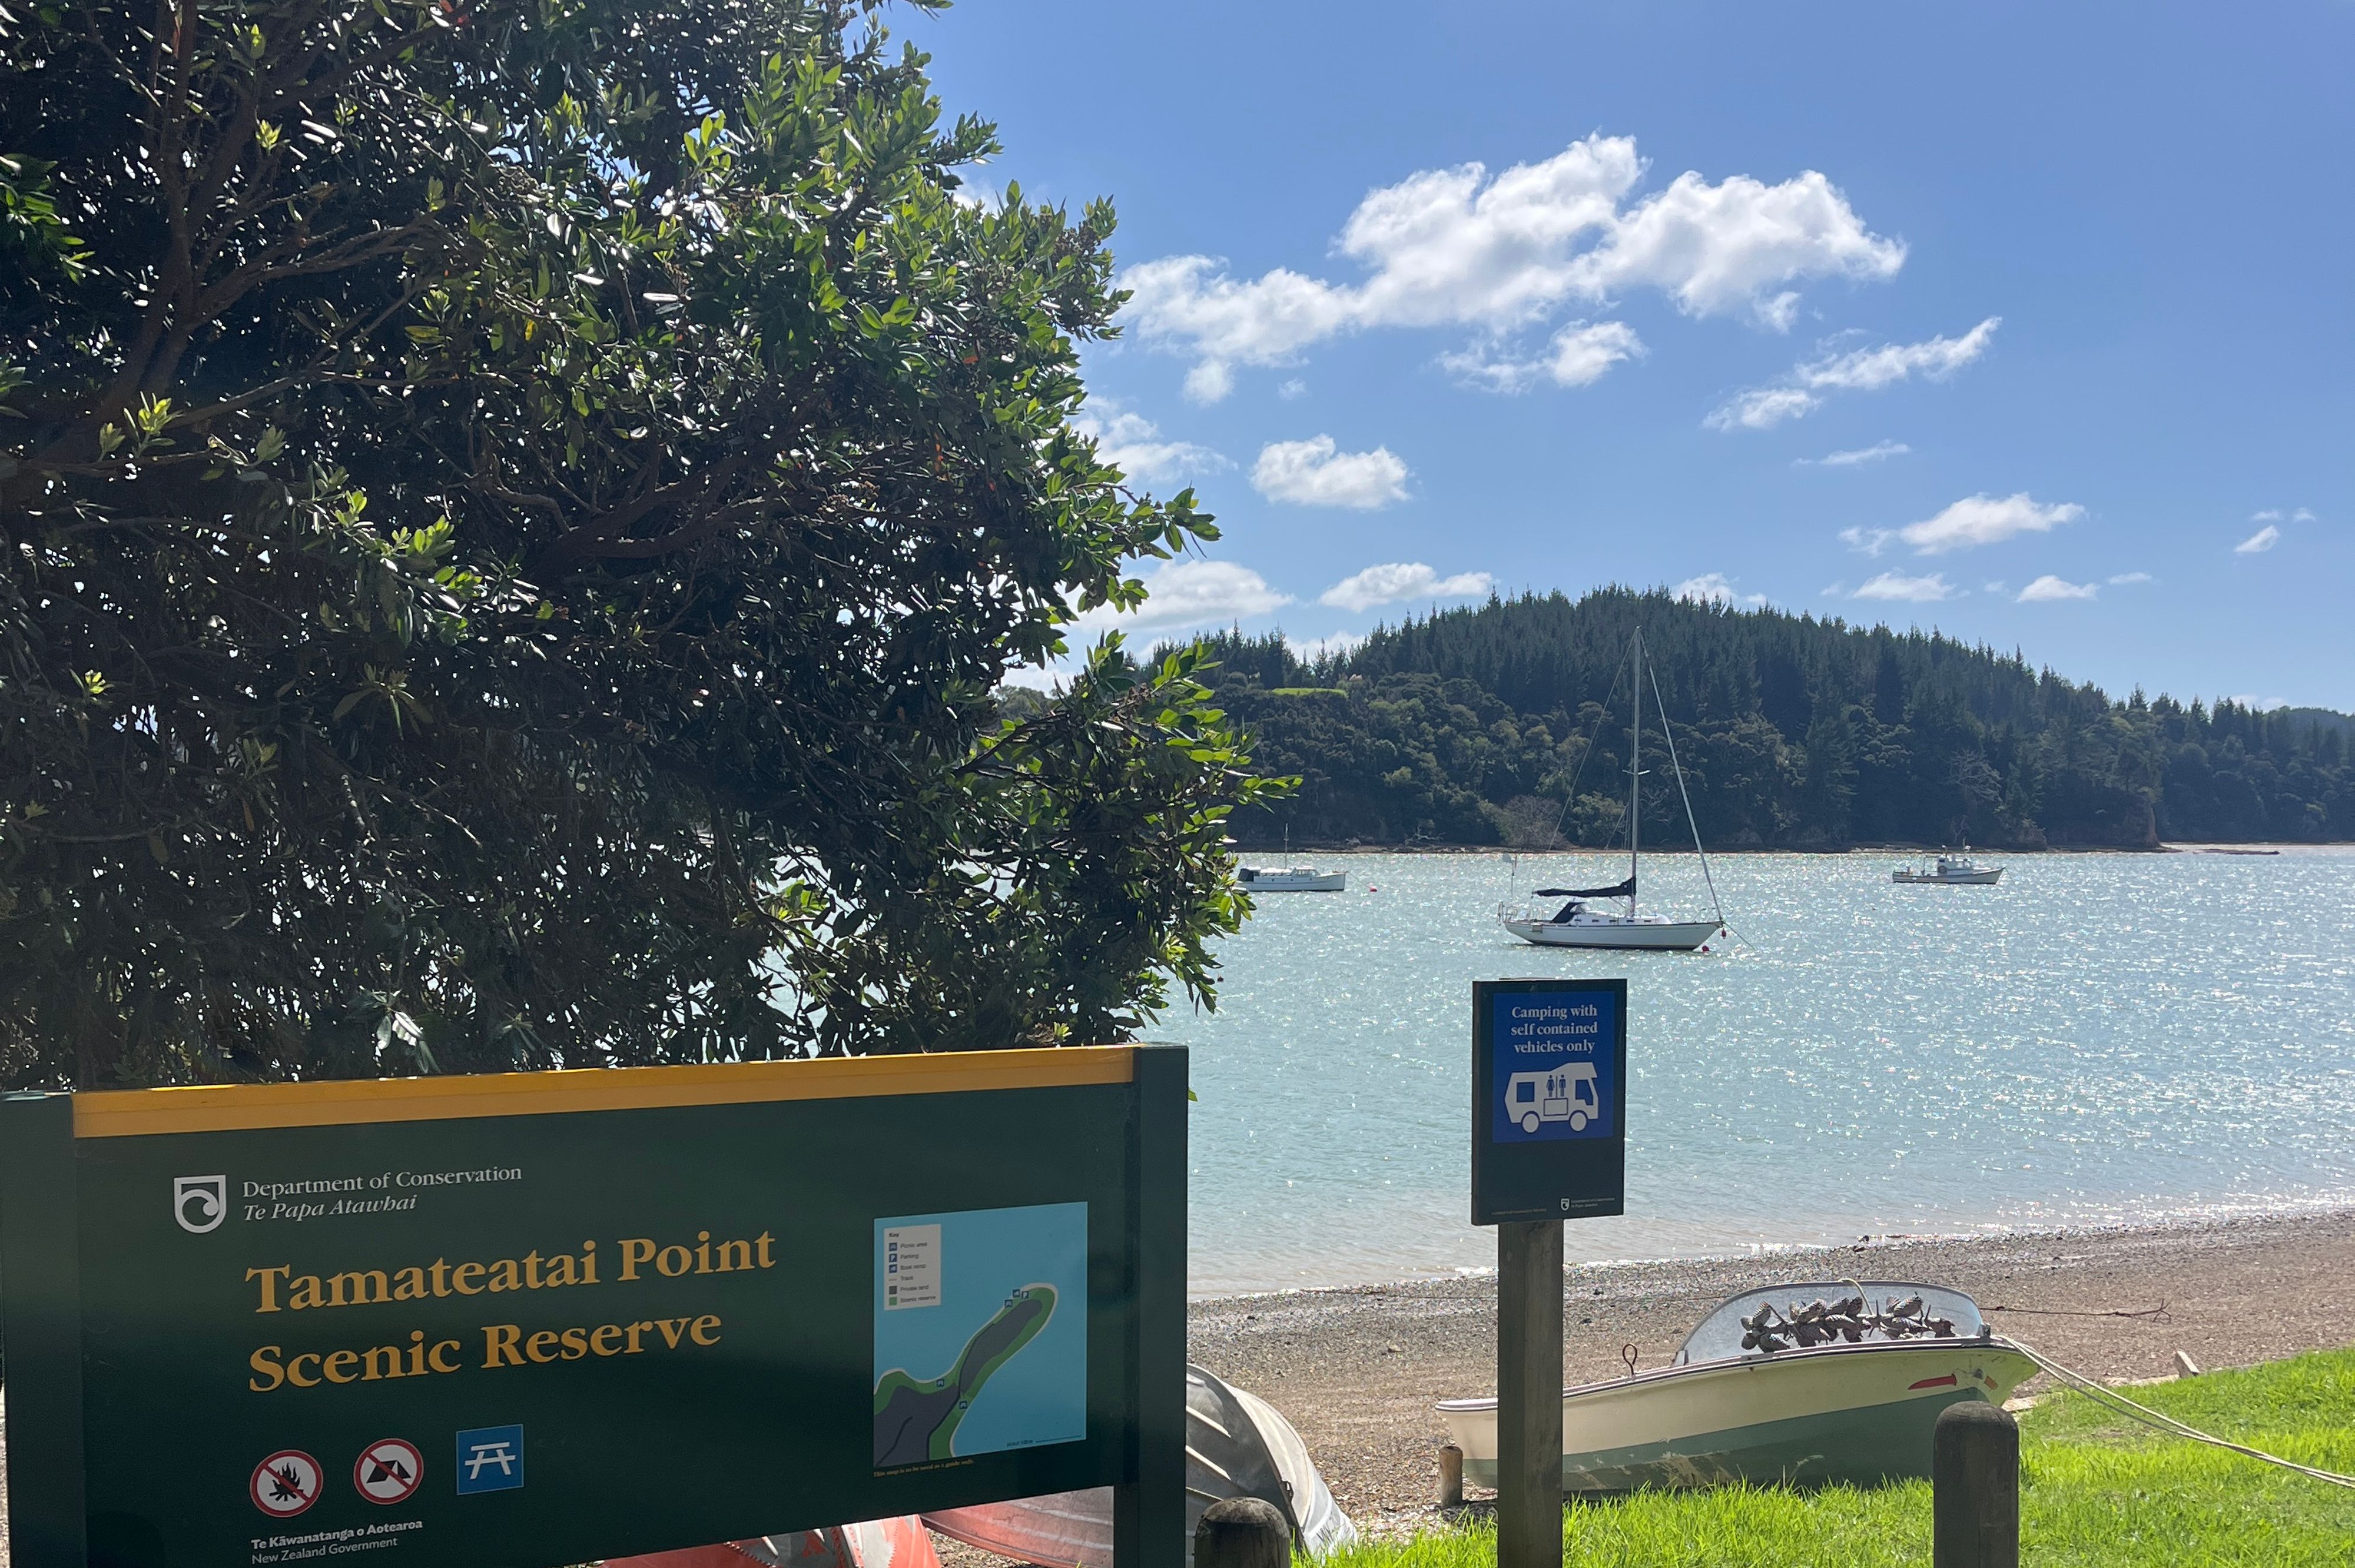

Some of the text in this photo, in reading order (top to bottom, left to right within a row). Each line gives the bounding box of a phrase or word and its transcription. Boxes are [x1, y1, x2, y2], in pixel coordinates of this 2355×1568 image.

[1512, 1004, 1597, 1021] Camping with
[1511, 1022, 1597, 1035] self contained
[1514, 1039, 1595, 1054] vehicles only
[244, 1167, 522, 1200] Department of Conservation
[244, 1205, 266, 1220] Te
[271, 1198, 324, 1221] Papa
[246, 1231, 775, 1312] Tamateatai Point
[250, 1315, 721, 1391] Scenic Reserve
[251, 1539, 266, 1549] Te
[270, 1529, 354, 1548] Kāwanatanga
[367, 1521, 423, 1534] Aotearoa
[252, 1537, 398, 1564] New Zealand Government
